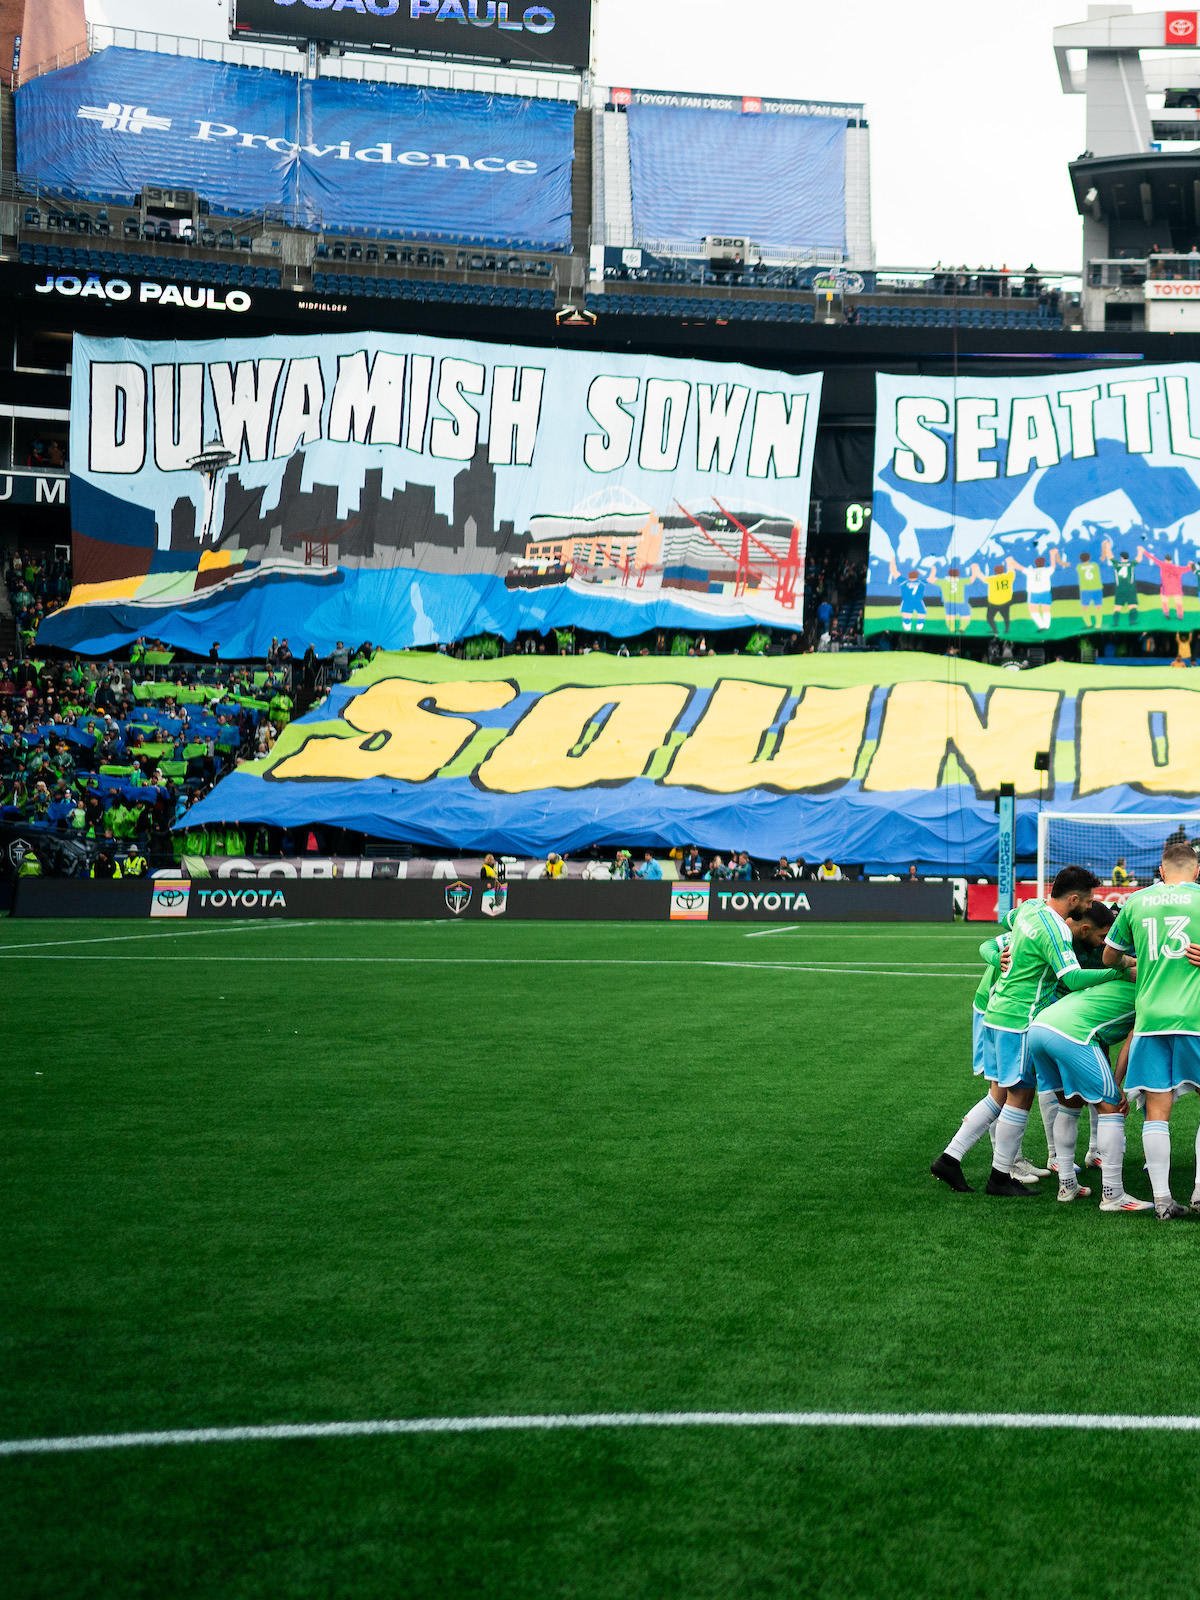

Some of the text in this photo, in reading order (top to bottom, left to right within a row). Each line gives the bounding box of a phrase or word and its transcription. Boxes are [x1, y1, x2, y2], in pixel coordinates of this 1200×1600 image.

[634, 93, 733, 111] TOYOTA FAN DECK
[763, 102, 861, 118] TOYOTA FAN DECK
[190, 119, 539, 175] Providence
[147, 188, 190, 203] 318
[712, 237, 744, 248] 320
[34, 273, 348, 313] JOÃO PAULO MIDFIELDER
[88, 349, 809, 479] DUWAMISH SOWN
[198, 889, 286, 907] TOYOTA
[718, 892, 811, 911] TOYOTA
[1142, 893, 1192, 907] MORRIS
[1142, 915, 1191, 961] 13
